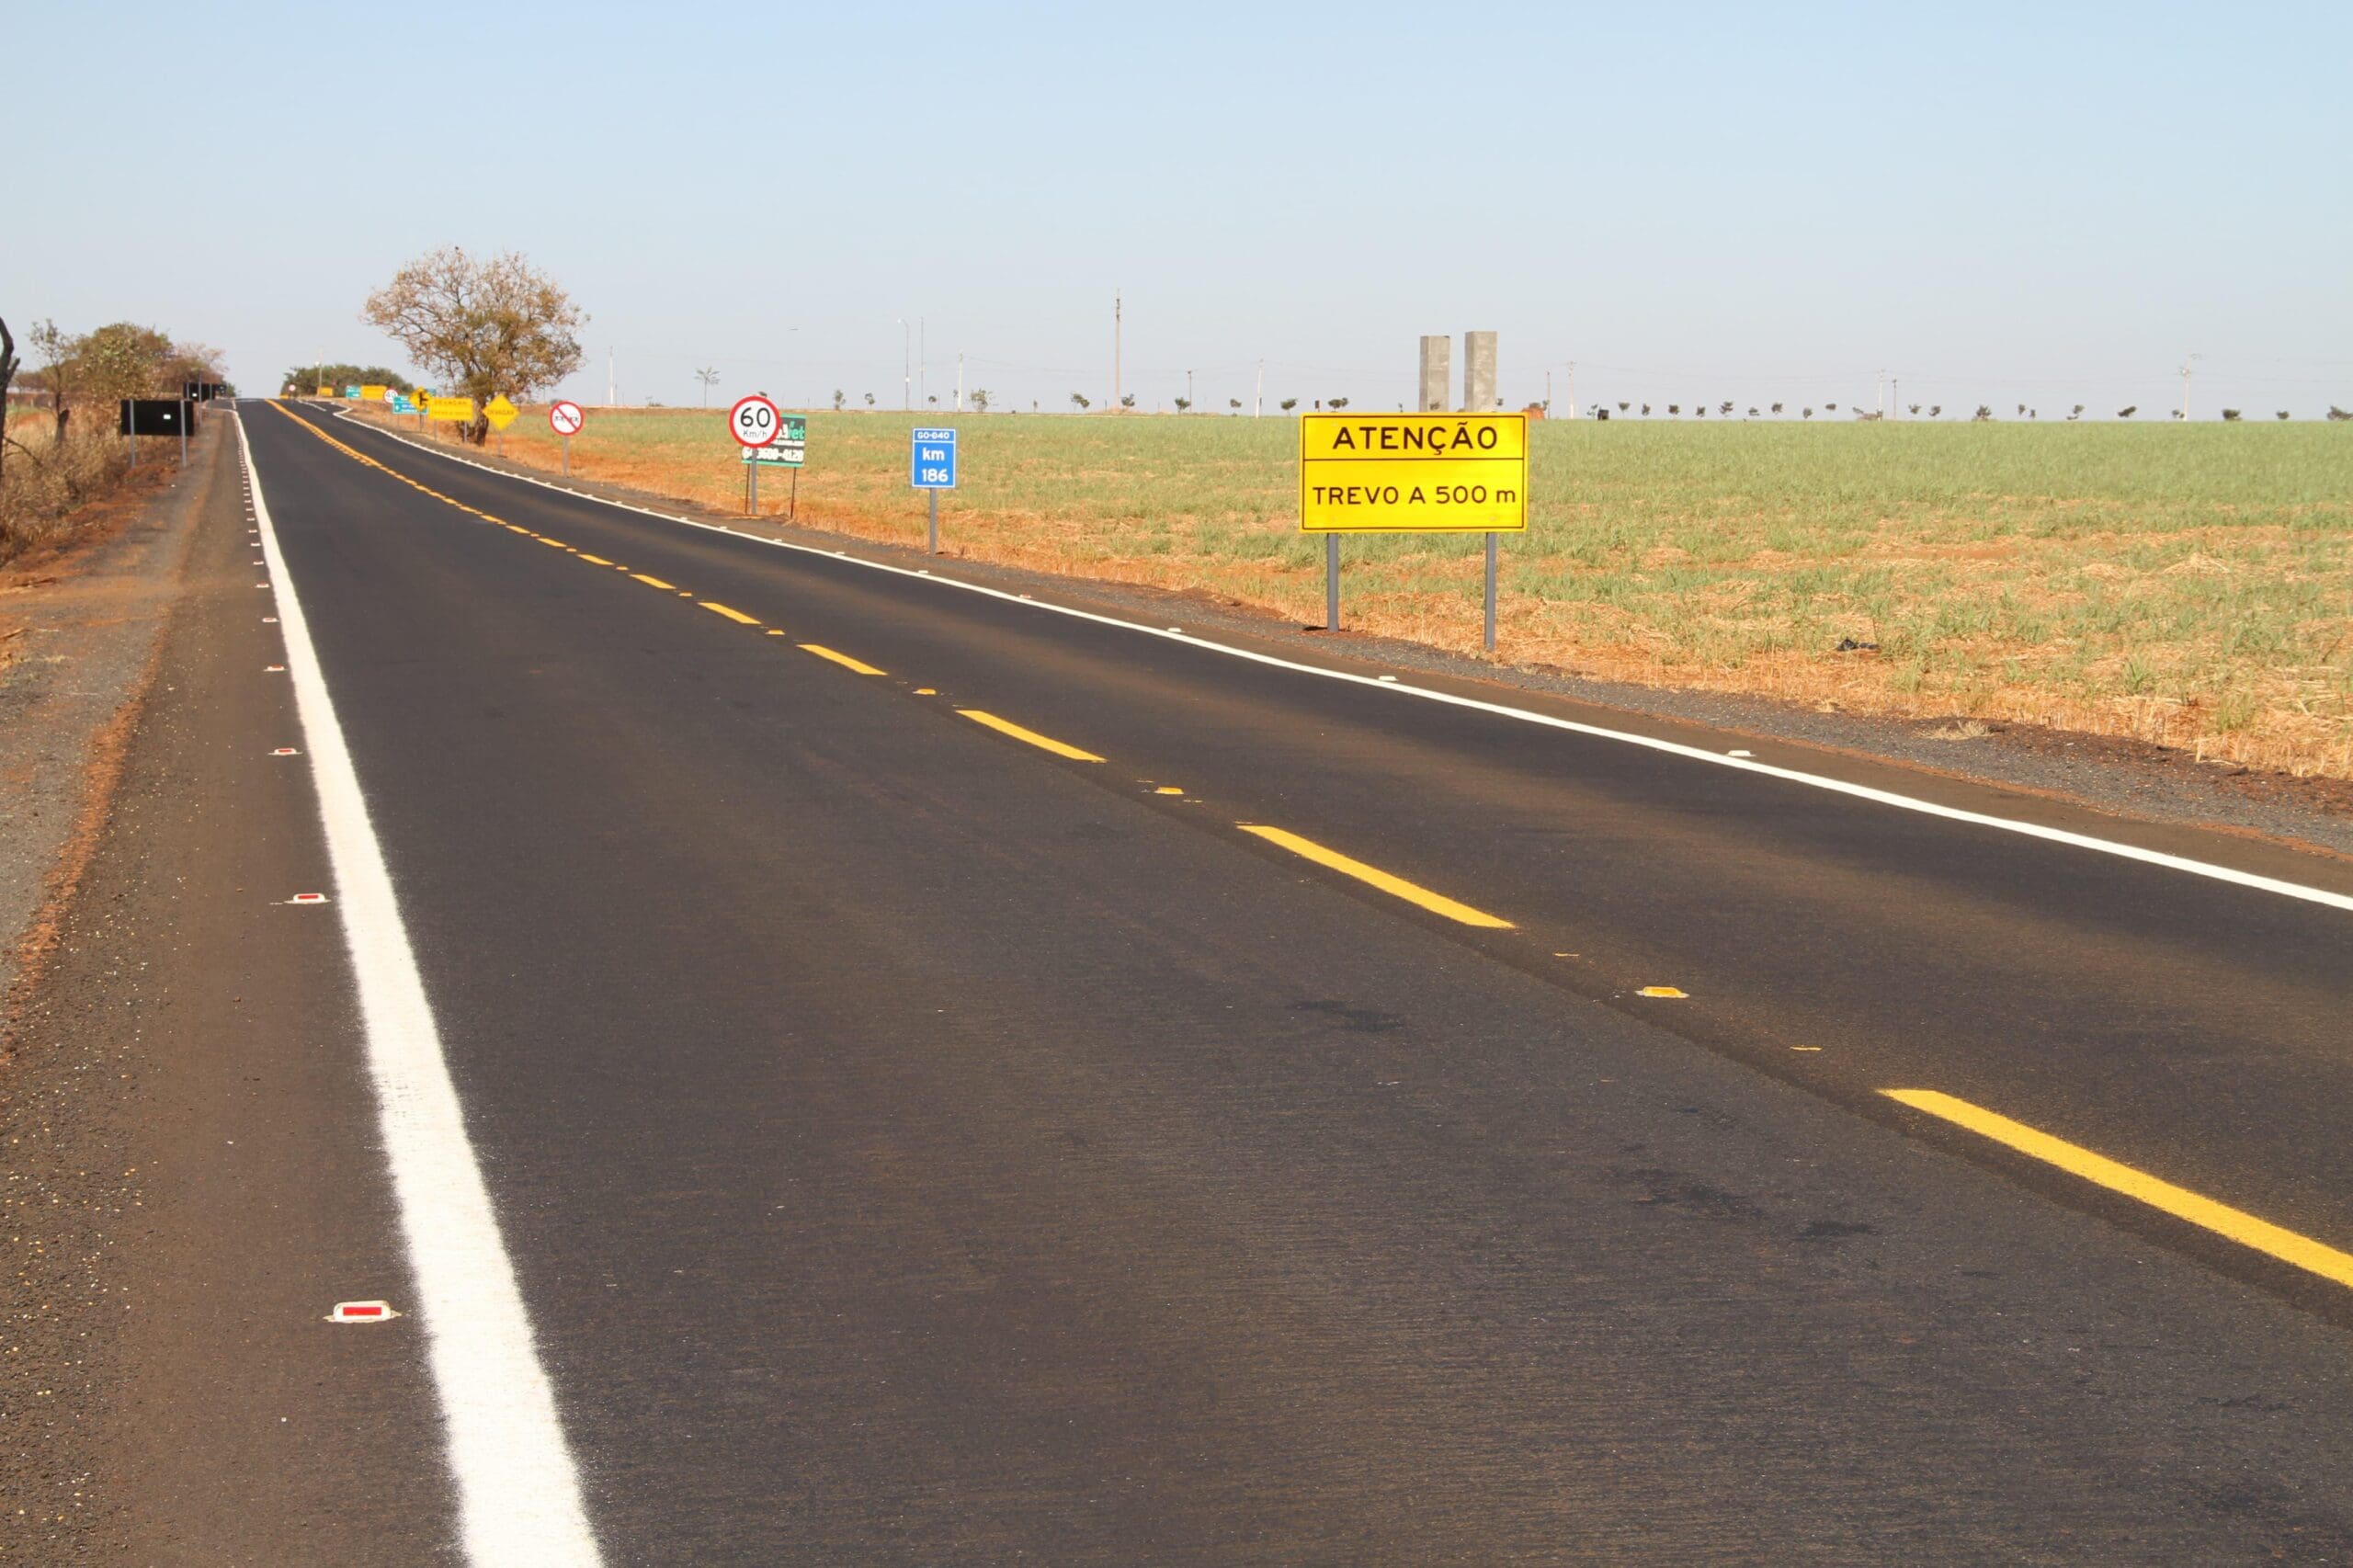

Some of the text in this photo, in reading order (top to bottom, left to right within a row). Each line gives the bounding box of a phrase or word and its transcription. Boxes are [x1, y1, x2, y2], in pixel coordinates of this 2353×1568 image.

[740, 406, 770, 427] 60
[743, 429, 767, 438] Km/h
[1332, 421, 1498, 455] ATENÇÃO
[922, 447, 945, 461] km
[922, 468, 949, 483] 186
[1313, 485, 1516, 505] TREVO A 500 m
